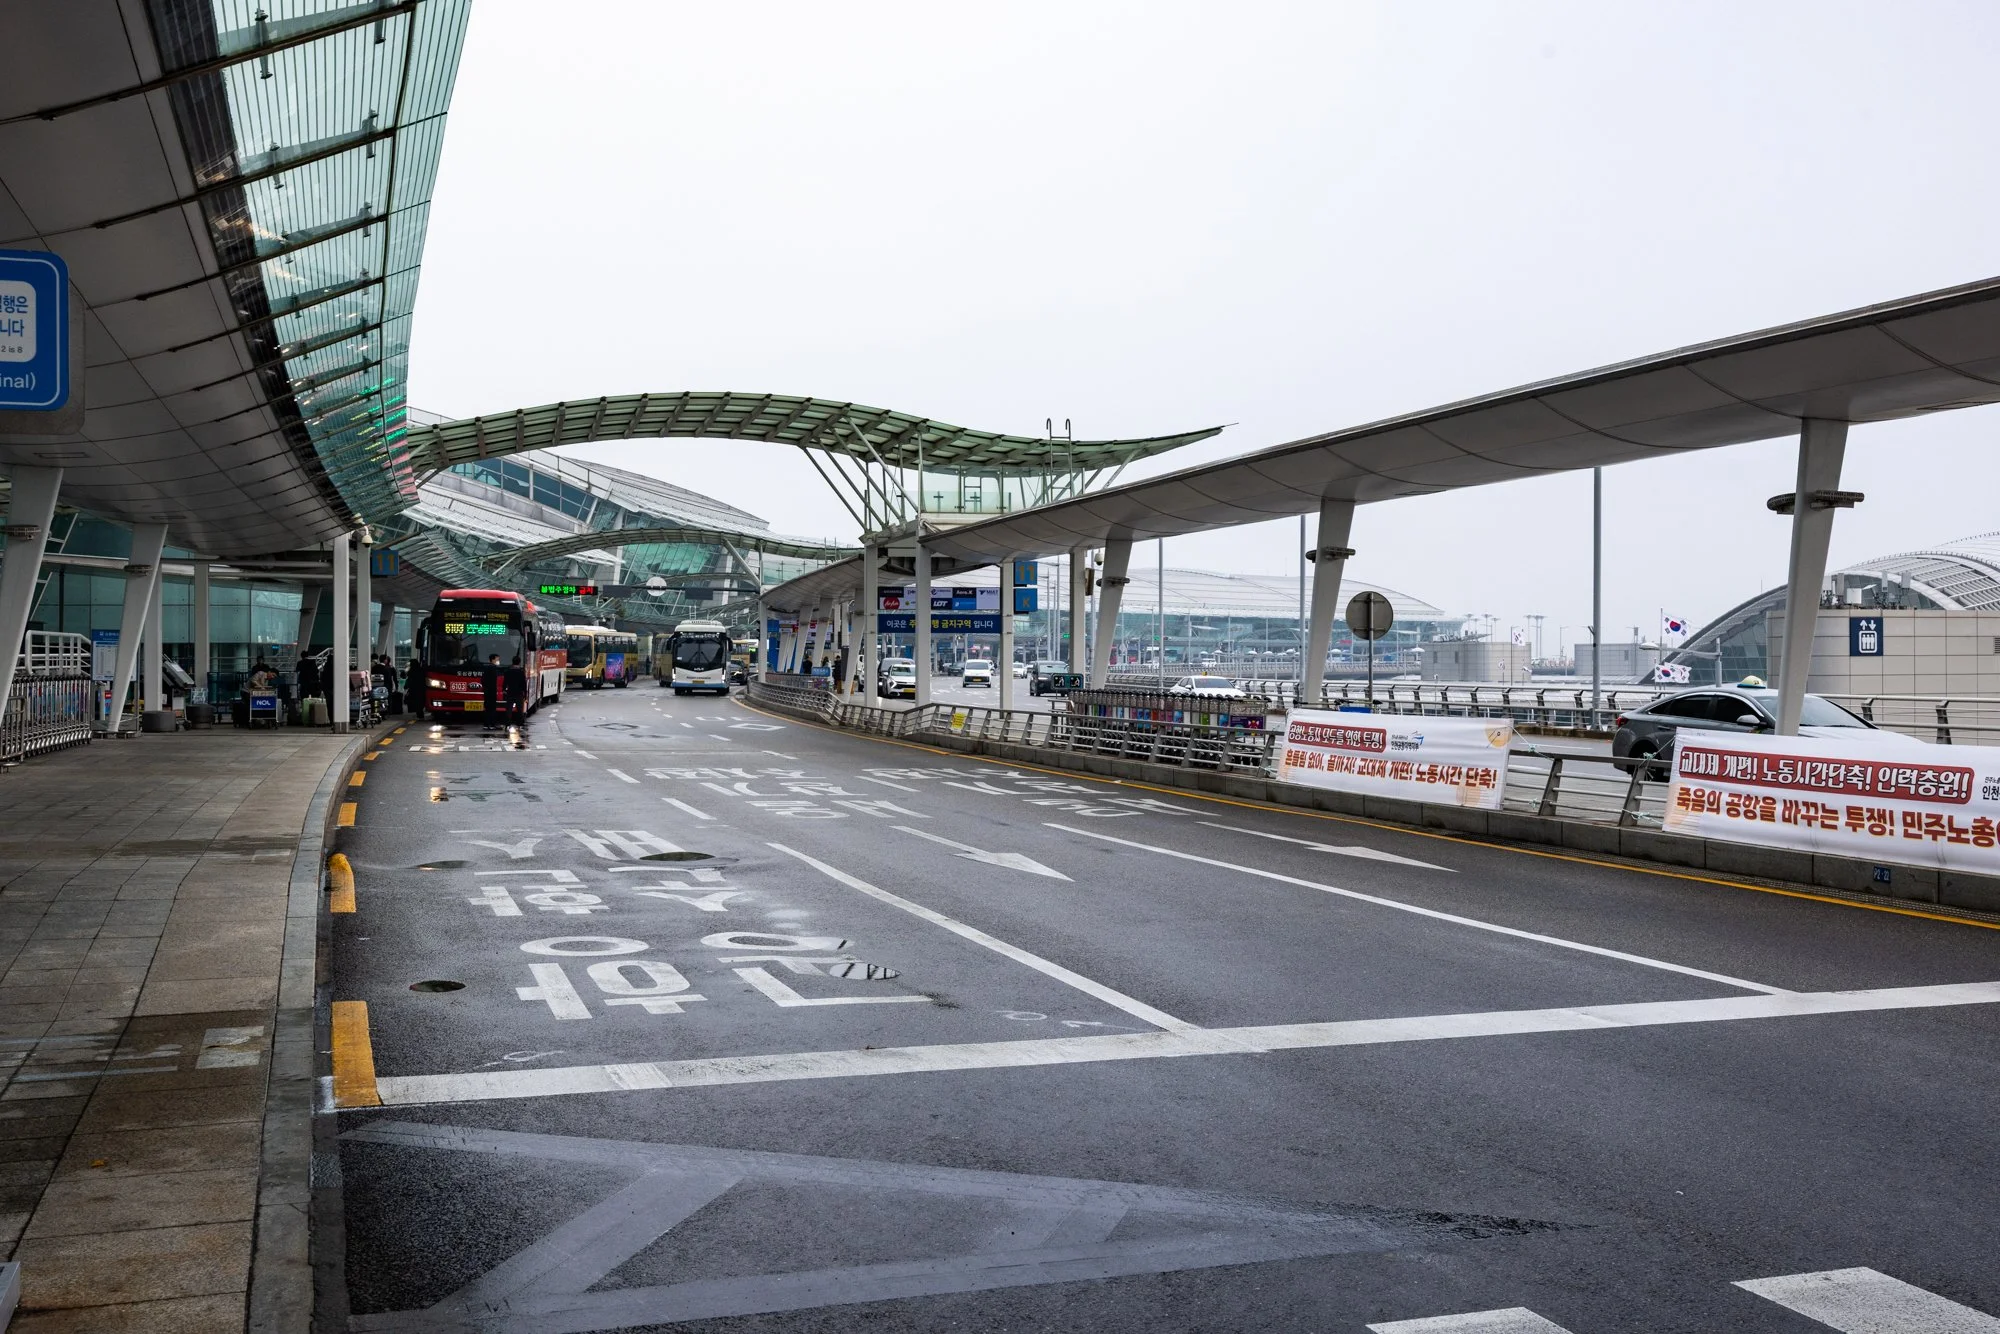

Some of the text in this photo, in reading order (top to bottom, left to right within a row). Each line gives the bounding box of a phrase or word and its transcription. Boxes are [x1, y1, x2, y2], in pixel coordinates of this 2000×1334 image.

[0, 295, 28, 314] 행은
[1018, 565, 1034, 581] 11
[579, 586, 593, 595] 금지
[1023, 596, 1031, 608] K
[445, 623, 464, 634] 6103
[887, 620, 907, 628] 이곳은
[942, 620, 972, 628] 금지구역
[974, 620, 994, 628] 입니다
[1327, 754, 1357, 774] 끝까지!
[1357, 757, 1388, 778] 교대제
[1389, 761, 1414, 781] 개편!
[1415, 763, 1462, 786] 노동시간
[1465, 767, 1498, 789] 단축!
[1680, 751, 1719, 776] 교대제
[1723, 755, 1758, 781] 개편!
[1877, 766, 1970, 799] 인력충원!
[699, 781, 867, 797] 장기
[941, 780, 1119, 796] 장기
[1982, 785, 2000, 801] 인천
[1677, 786, 1996, 848] 죽음의 공항을 바꾸는 투쟁! 민주노총
[449, 828, 686, 862] 버스
[468, 866, 745, 917] 순환
[516, 932, 935, 1021] 공항
